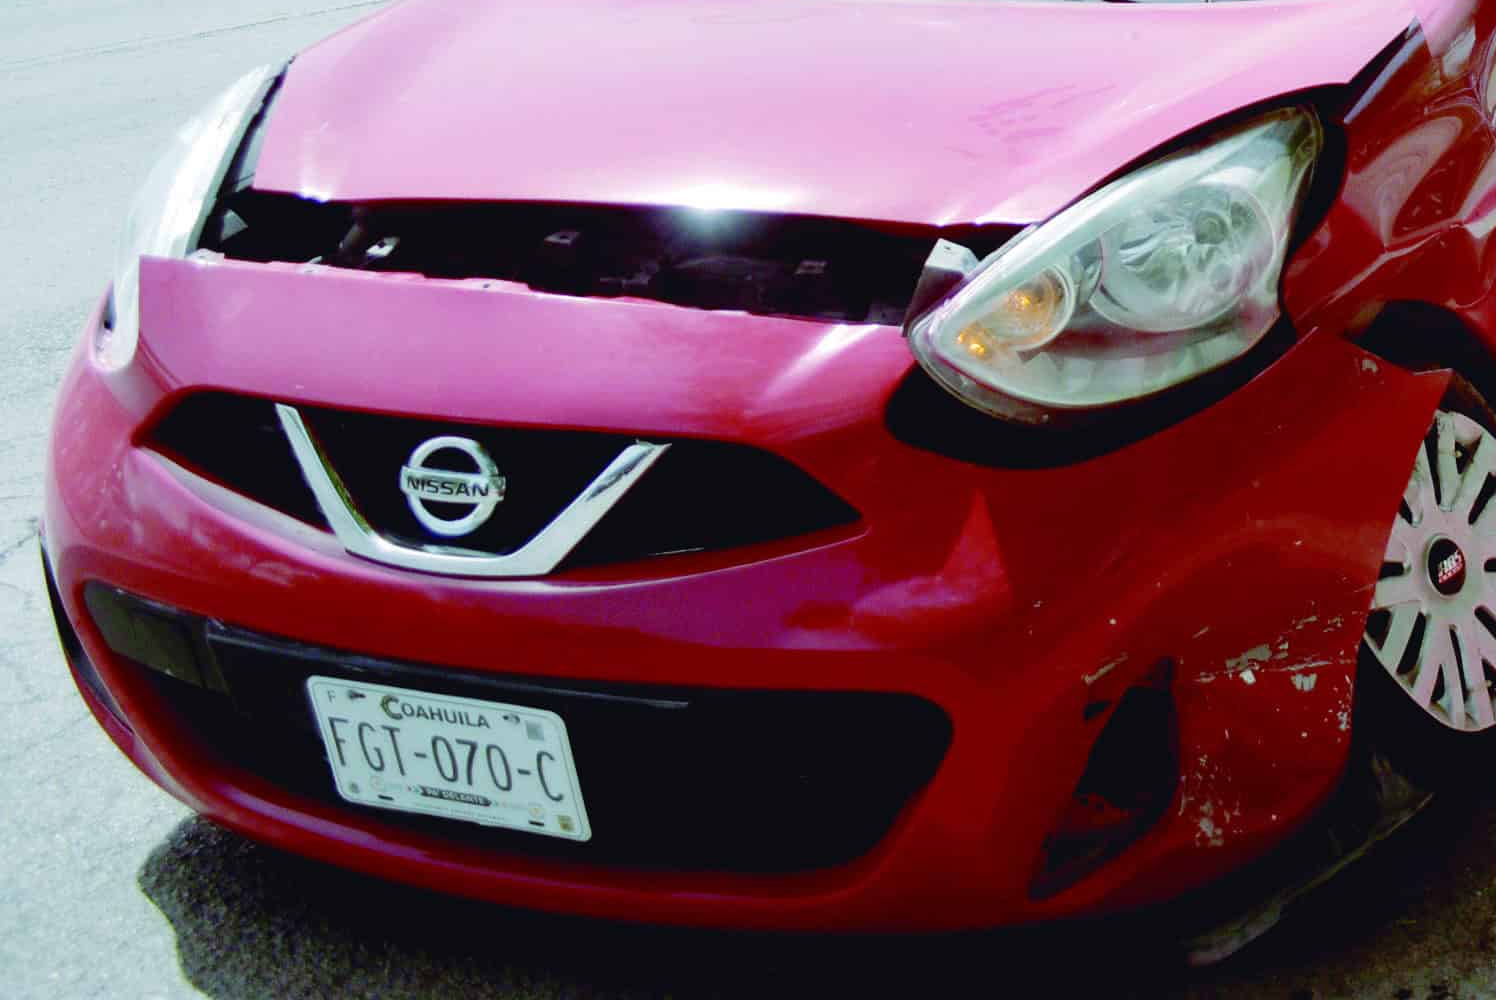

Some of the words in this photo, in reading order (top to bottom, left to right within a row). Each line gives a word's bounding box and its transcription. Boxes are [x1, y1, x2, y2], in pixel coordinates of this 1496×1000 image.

[406, 476, 490, 497] NISSAN
[381, 694, 491, 729] COAHUILA
[327, 716, 564, 802] FGT-070-C
